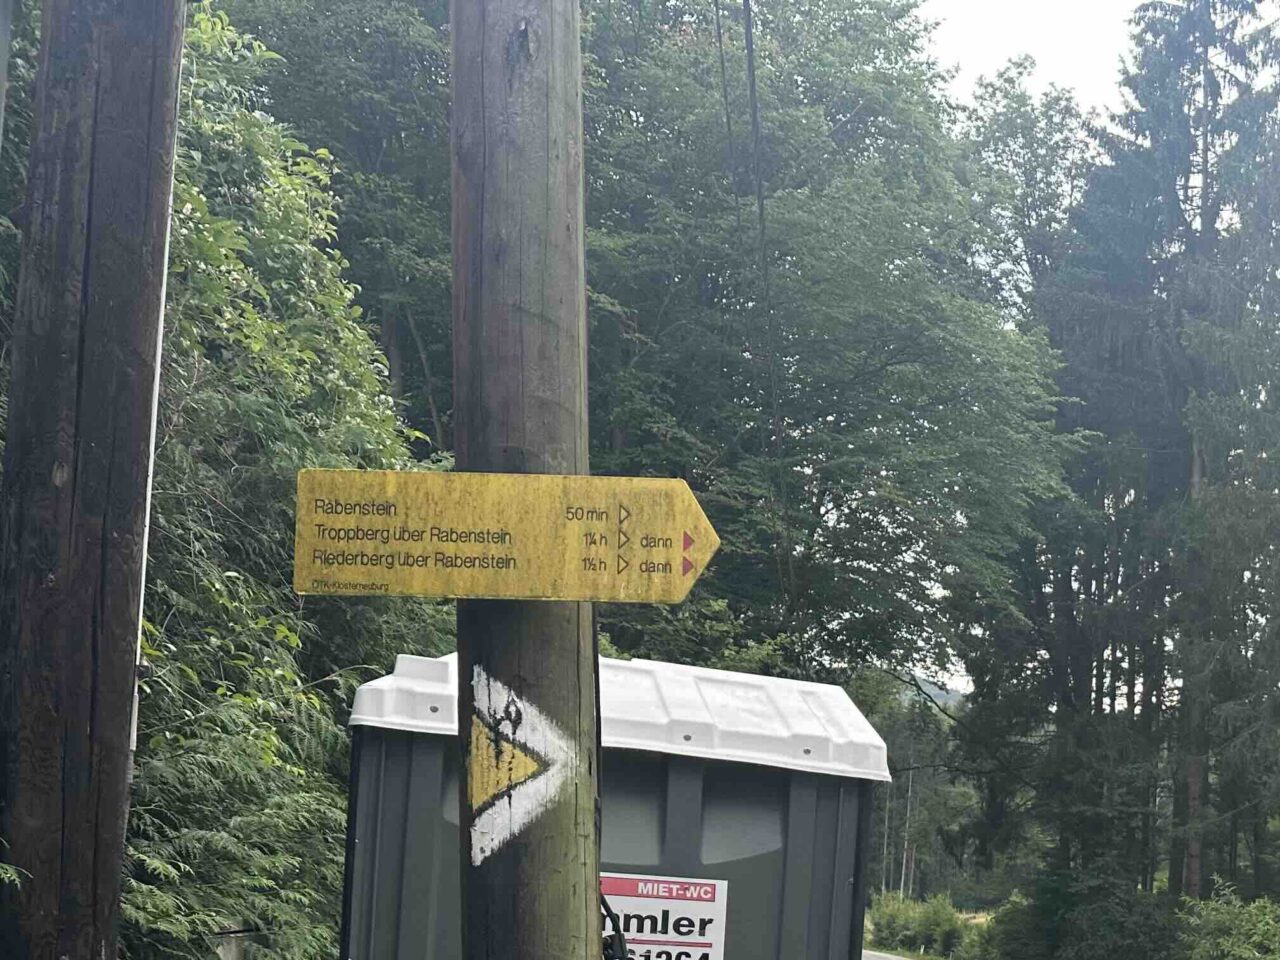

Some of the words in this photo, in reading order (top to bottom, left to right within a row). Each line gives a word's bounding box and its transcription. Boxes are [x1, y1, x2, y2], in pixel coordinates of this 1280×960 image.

[314, 498, 397, 516] Rabenstein
[566, 506, 584, 521] 50
[586, 507, 609, 522] min
[314, 524, 390, 544] Troppberg
[393, 525, 427, 542] über
[430, 527, 512, 544] Rabenstein
[599, 533, 608, 546] h
[640, 534, 673, 548] dann
[312, 549, 395, 570] Riederberg
[398, 551, 432, 567] über
[434, 552, 517, 569] Rabenstein
[598, 557, 607, 571] h
[639, 559, 672, 574] dann
[637, 882, 712, 898] MIET-WC
